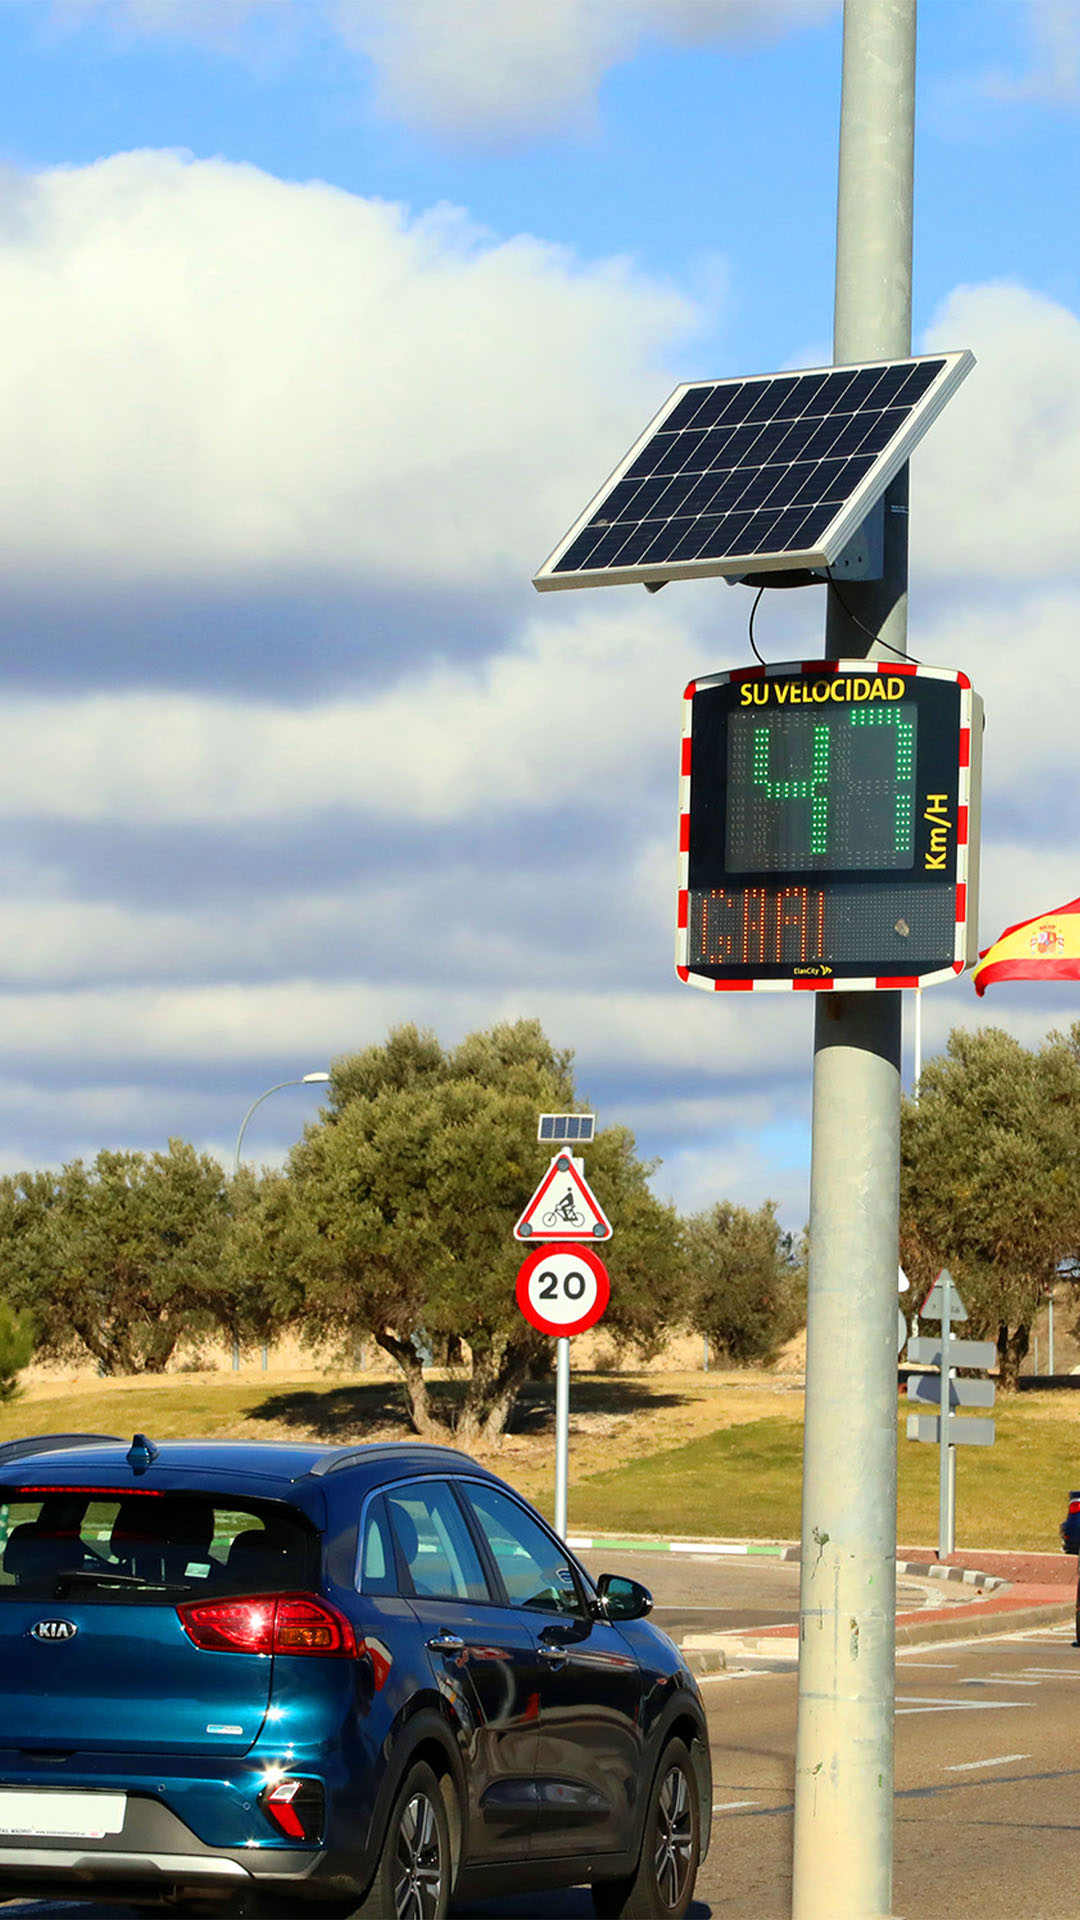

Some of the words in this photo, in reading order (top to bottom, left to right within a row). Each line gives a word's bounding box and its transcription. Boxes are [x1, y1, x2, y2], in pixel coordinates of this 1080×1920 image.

[740, 683, 769, 706] SU
[774, 677, 906, 704] VELOCIDAD
[754, 708, 913, 854] 47
[924, 794, 952, 870] Km/H
[793, 967, 820, 976] ElanCity
[538, 1272, 586, 1300] 20
[39, 1623, 69, 1637] KIA
